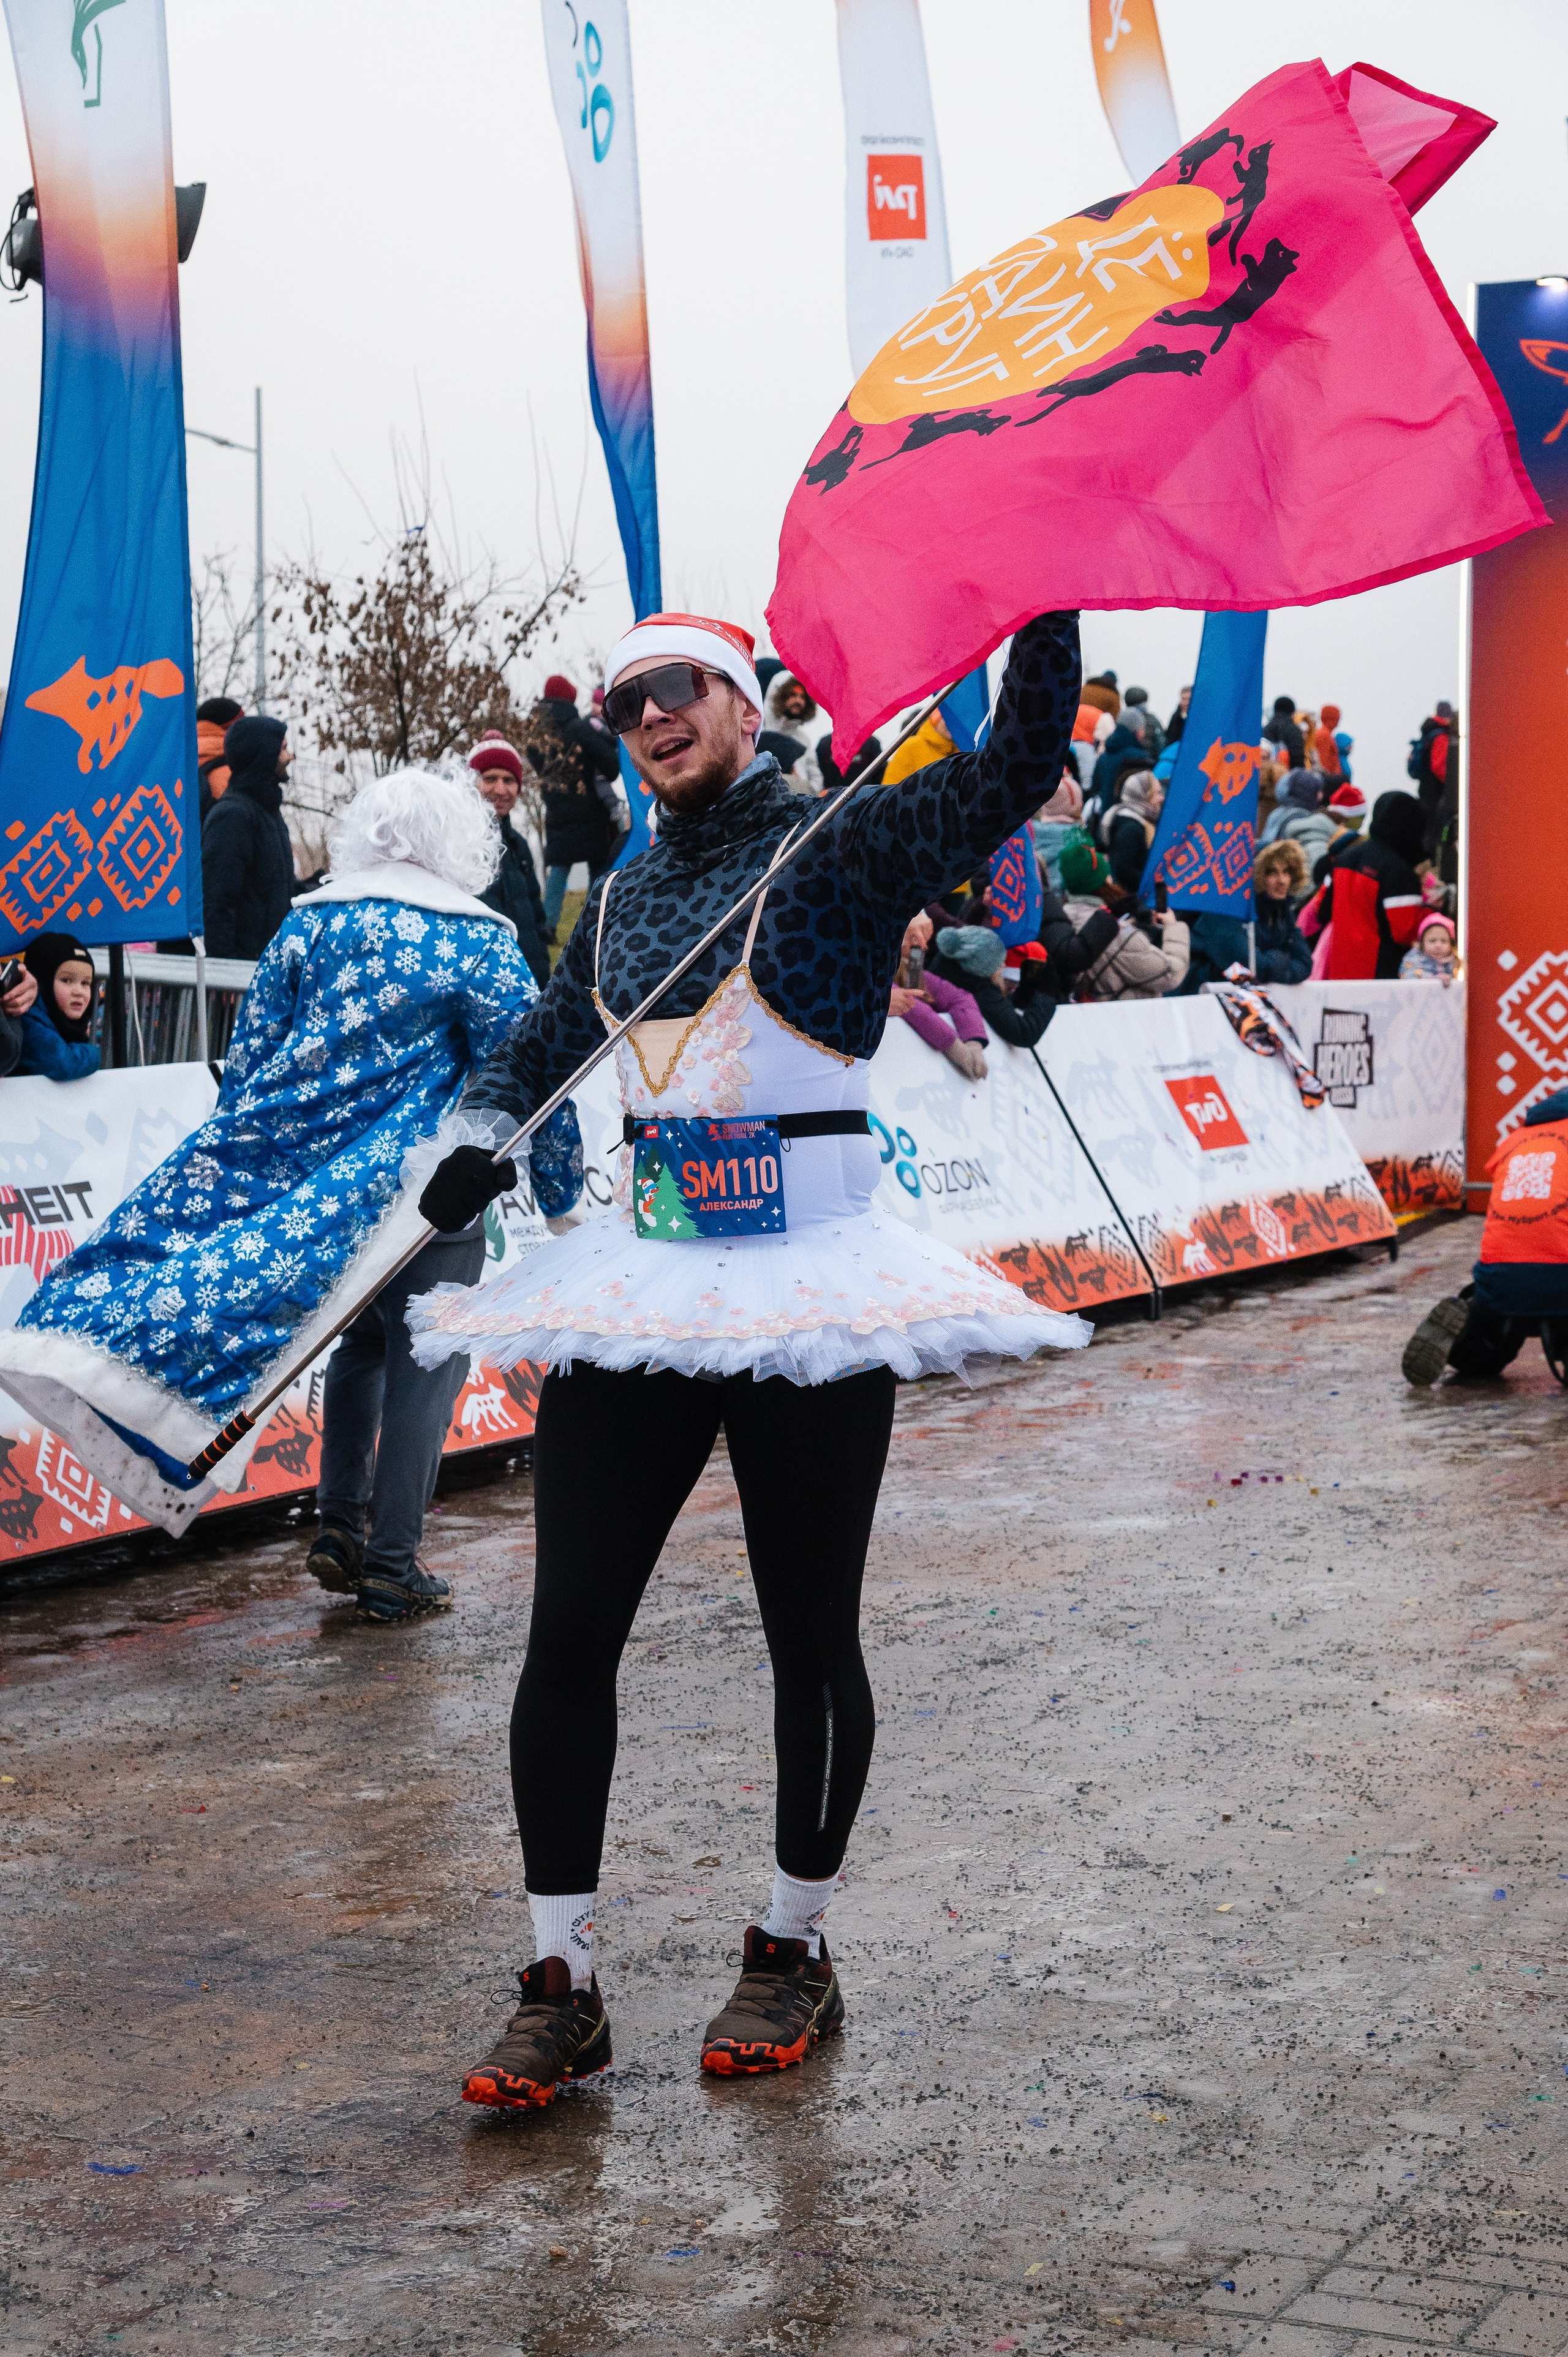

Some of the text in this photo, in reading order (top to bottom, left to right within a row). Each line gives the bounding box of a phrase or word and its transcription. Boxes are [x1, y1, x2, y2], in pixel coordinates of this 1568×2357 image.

[722, 1120, 766, 1134] SNOWMAN
[682, 1155, 778, 1199] SM110
[921, 1158, 990, 1194] OZON
[0, 1181, 93, 1229] HEIT
[699, 1199, 764, 1212] АЛЕКСАНДР
[571, 1910, 590, 1927] CITY
